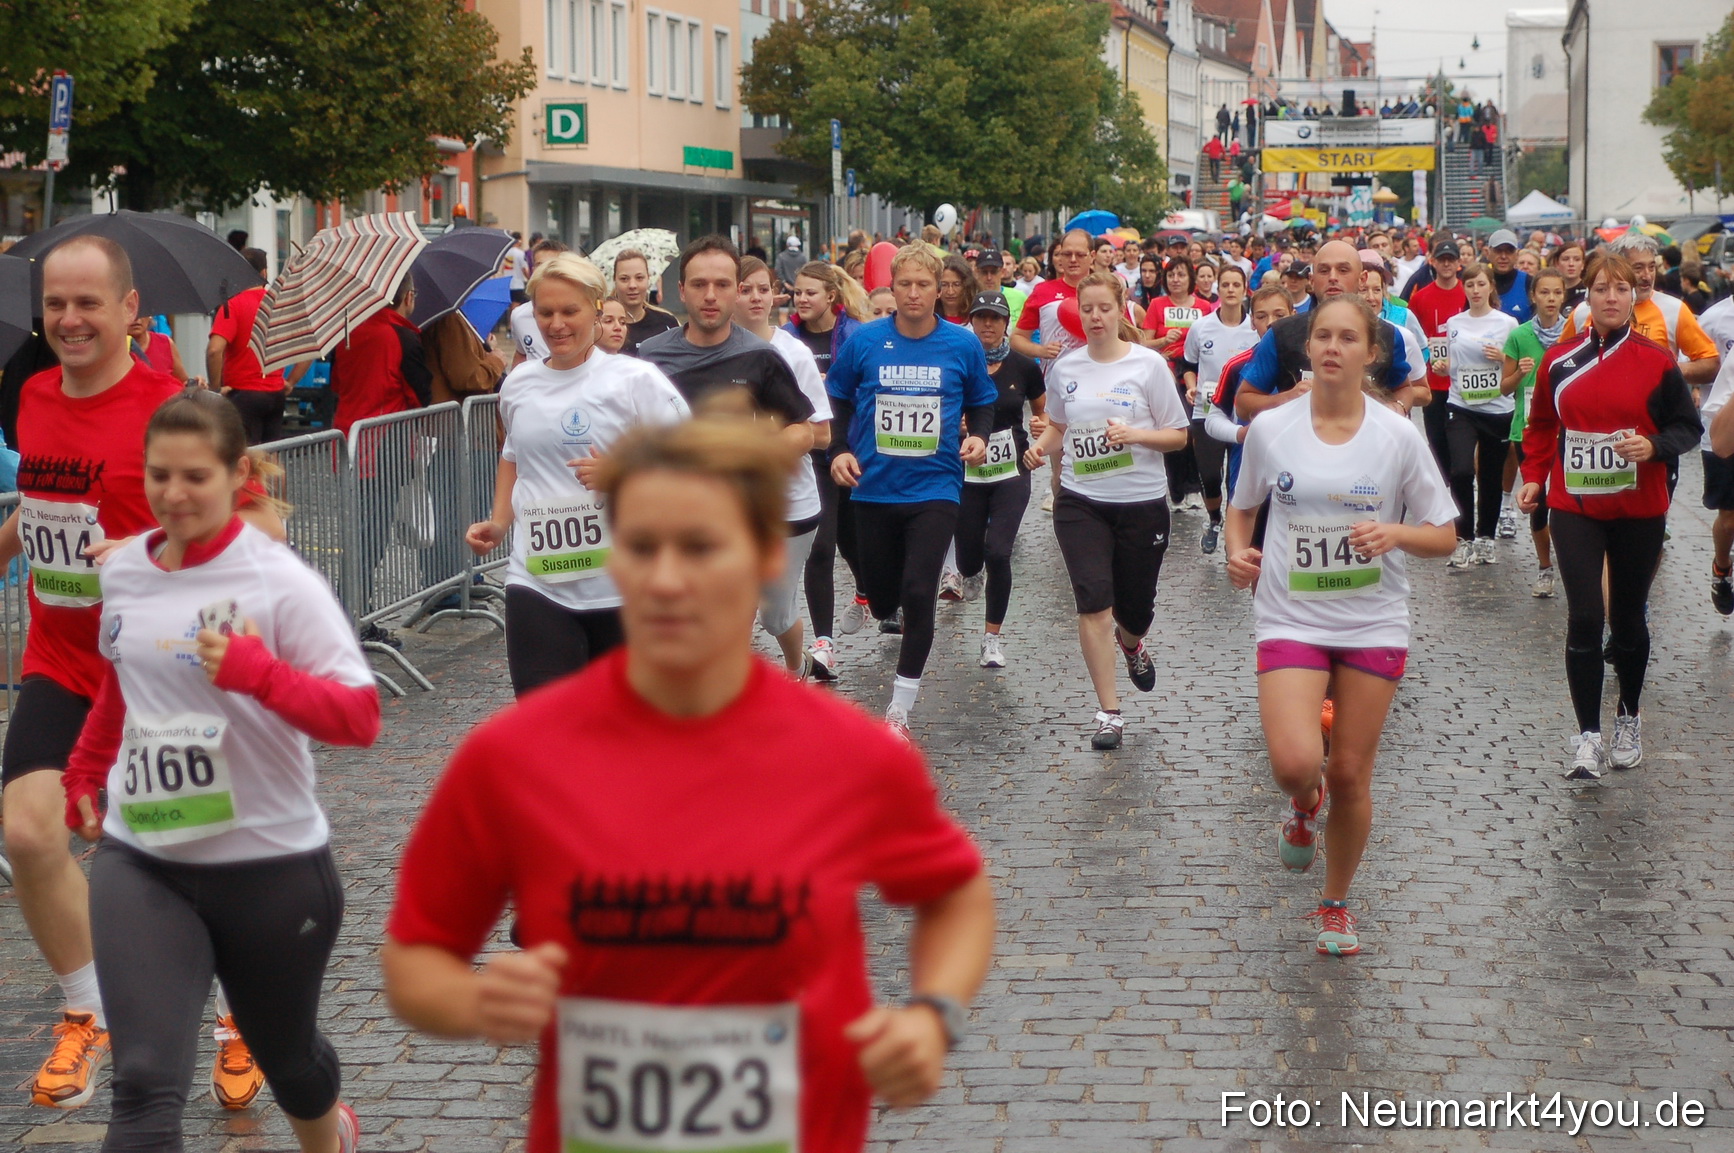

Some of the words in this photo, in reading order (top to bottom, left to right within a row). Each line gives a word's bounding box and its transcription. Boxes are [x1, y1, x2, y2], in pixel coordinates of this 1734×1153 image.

[55, 83, 68, 122] P
[552, 109, 581, 139] D
[1318, 153, 1376, 166] START
[1168, 307, 1198, 320] 5079
[879, 365, 941, 379] HUBER
[1462, 372, 1498, 389] 5053
[881, 410, 935, 433] 5112
[889, 438, 923, 448] Thomas
[978, 466, 1003, 477] Brigitte
[1084, 460, 1119, 472] Stefanie
[1582, 476, 1616, 485] Andrea
[37, 510, 82, 524] Neumarkt
[524, 507, 546, 517] PARTL
[547, 503, 590, 515] Neumarkt
[530, 514, 602, 552] 5005
[1288, 523, 1316, 534] PARTL
[22, 522, 95, 567] 5014
[542, 556, 592, 572] Susanne
[36, 573, 82, 594] Andreas
[1317, 576, 1351, 589] Elena
[139, 726, 197, 739] Neumarkt
[124, 744, 215, 796] 5166
[127, 805, 186, 825] Sandra
[581, 1053, 773, 1138] 5023
